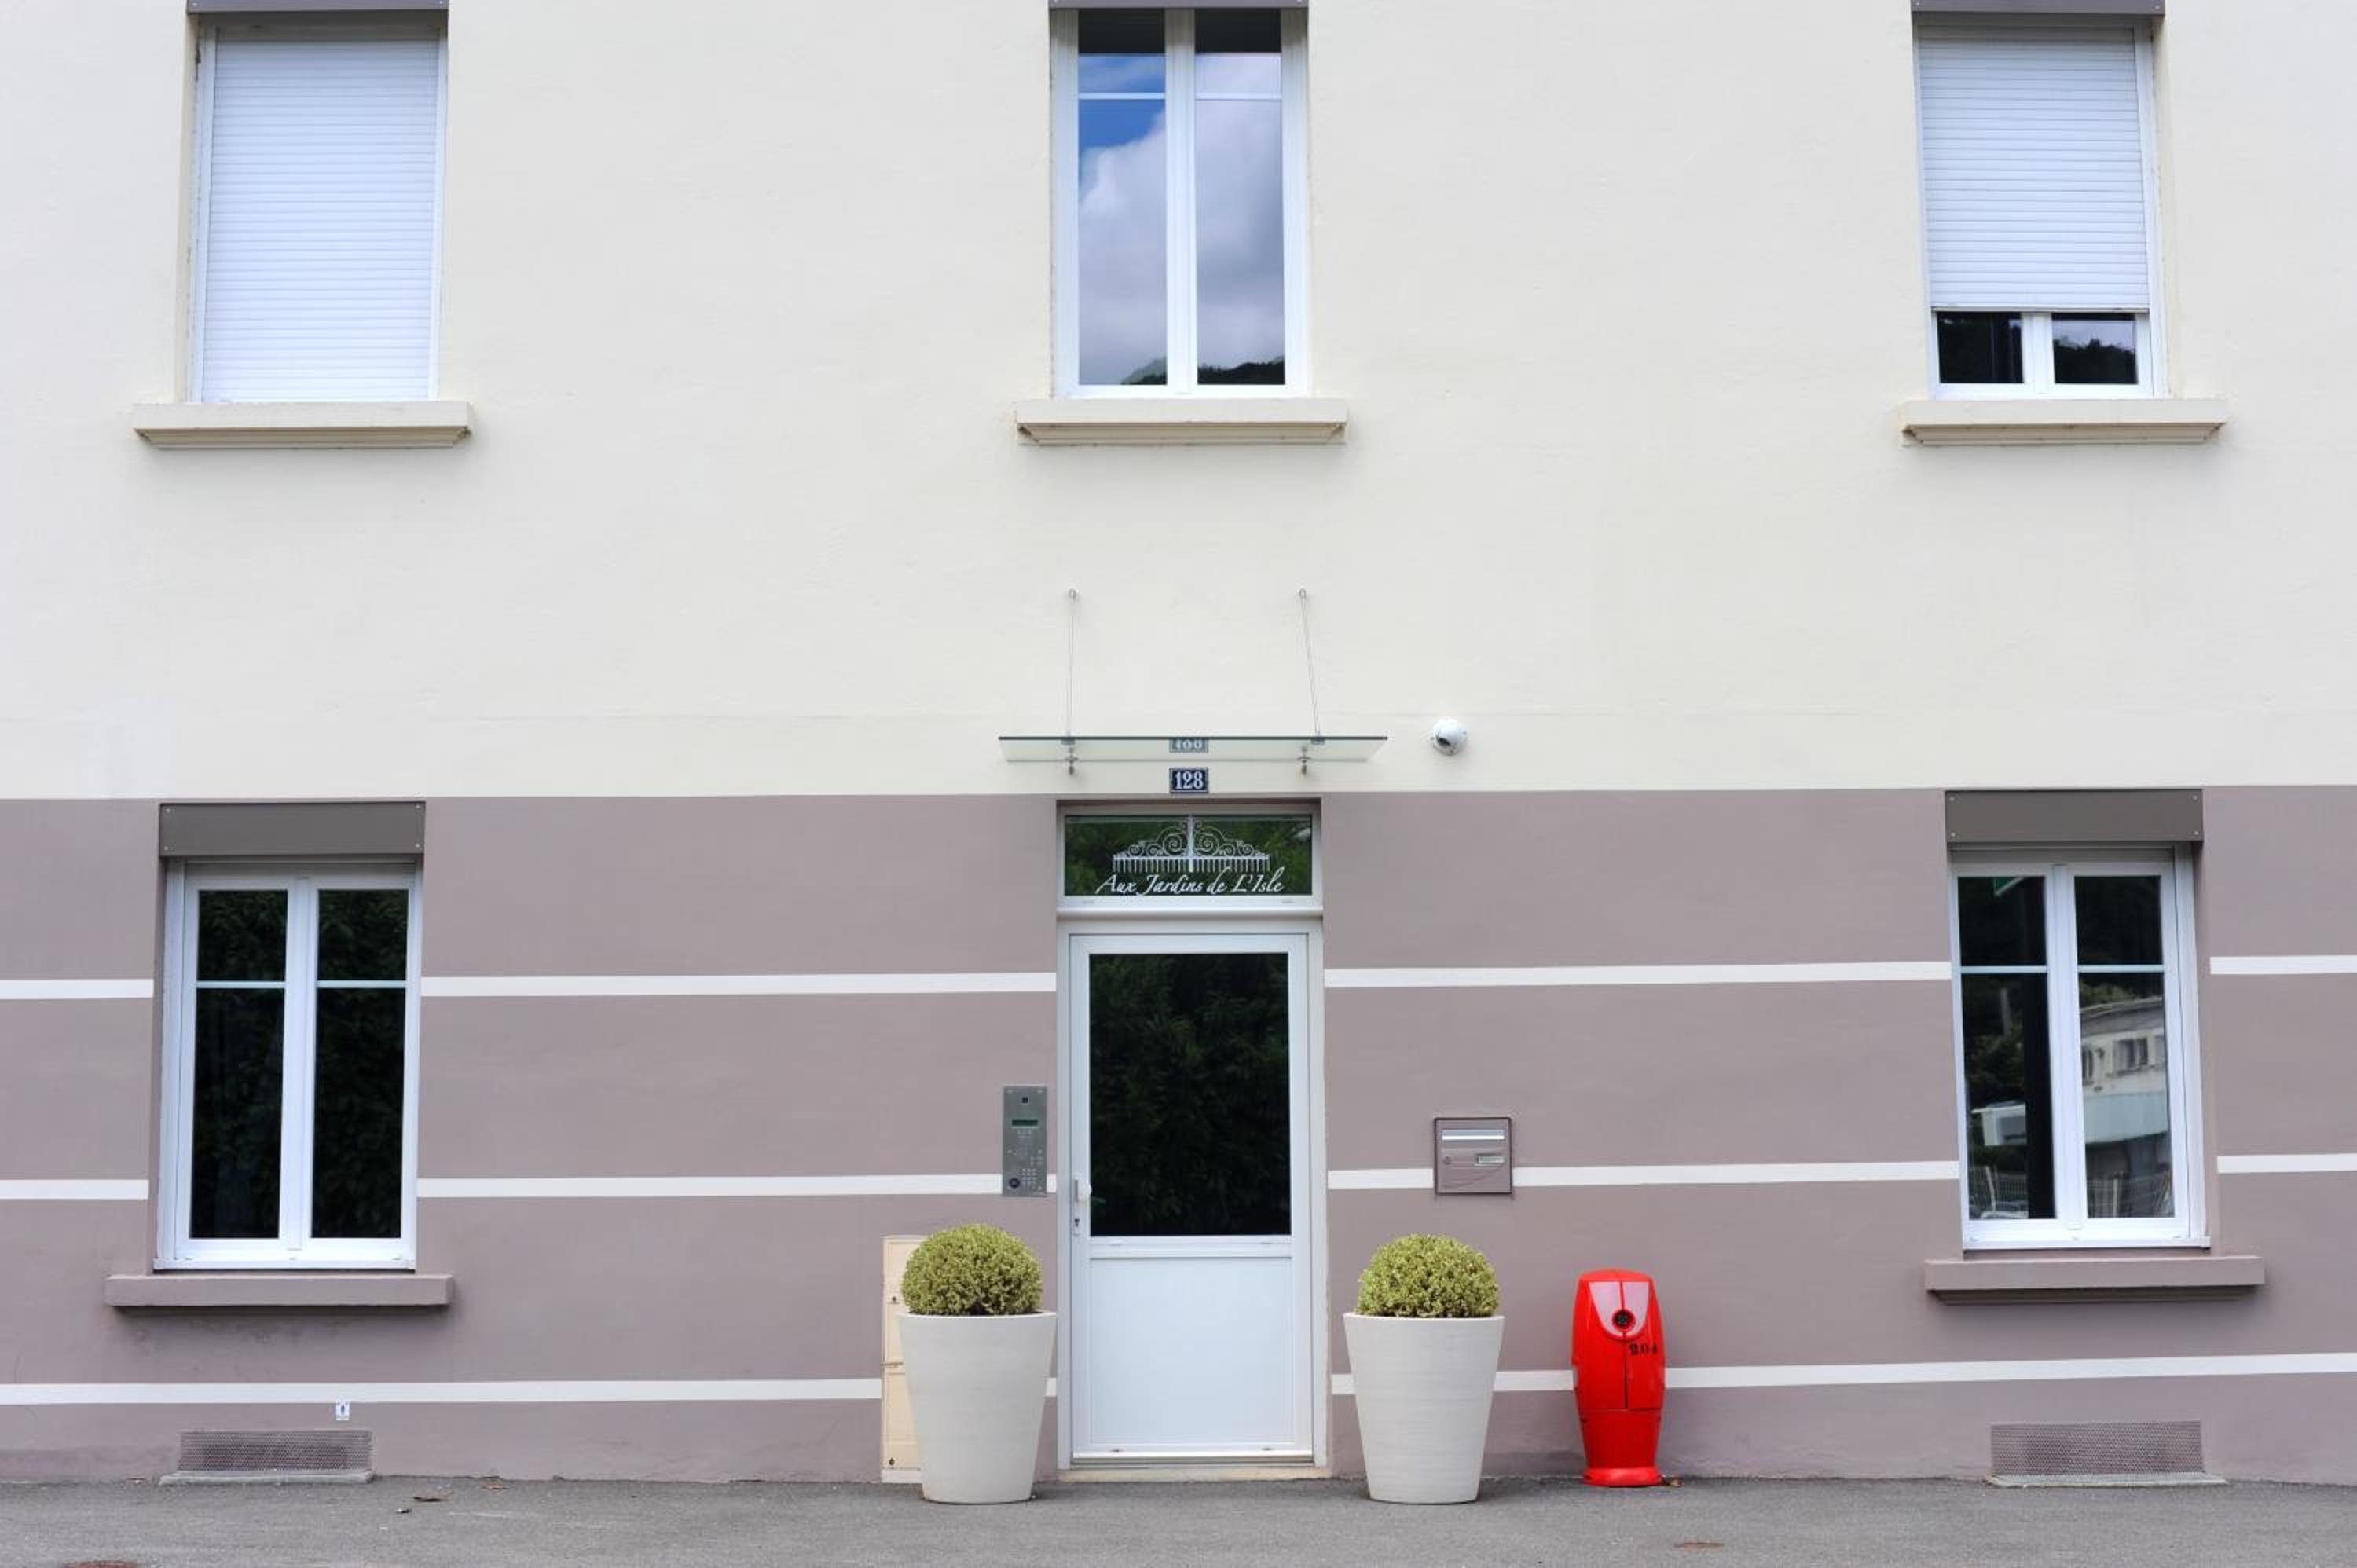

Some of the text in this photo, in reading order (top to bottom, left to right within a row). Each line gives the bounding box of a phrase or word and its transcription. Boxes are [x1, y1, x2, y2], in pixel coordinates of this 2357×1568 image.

[1175, 771, 1204, 789] 128
[1094, 866, 1285, 896] Aux Jardins de L'Isle
